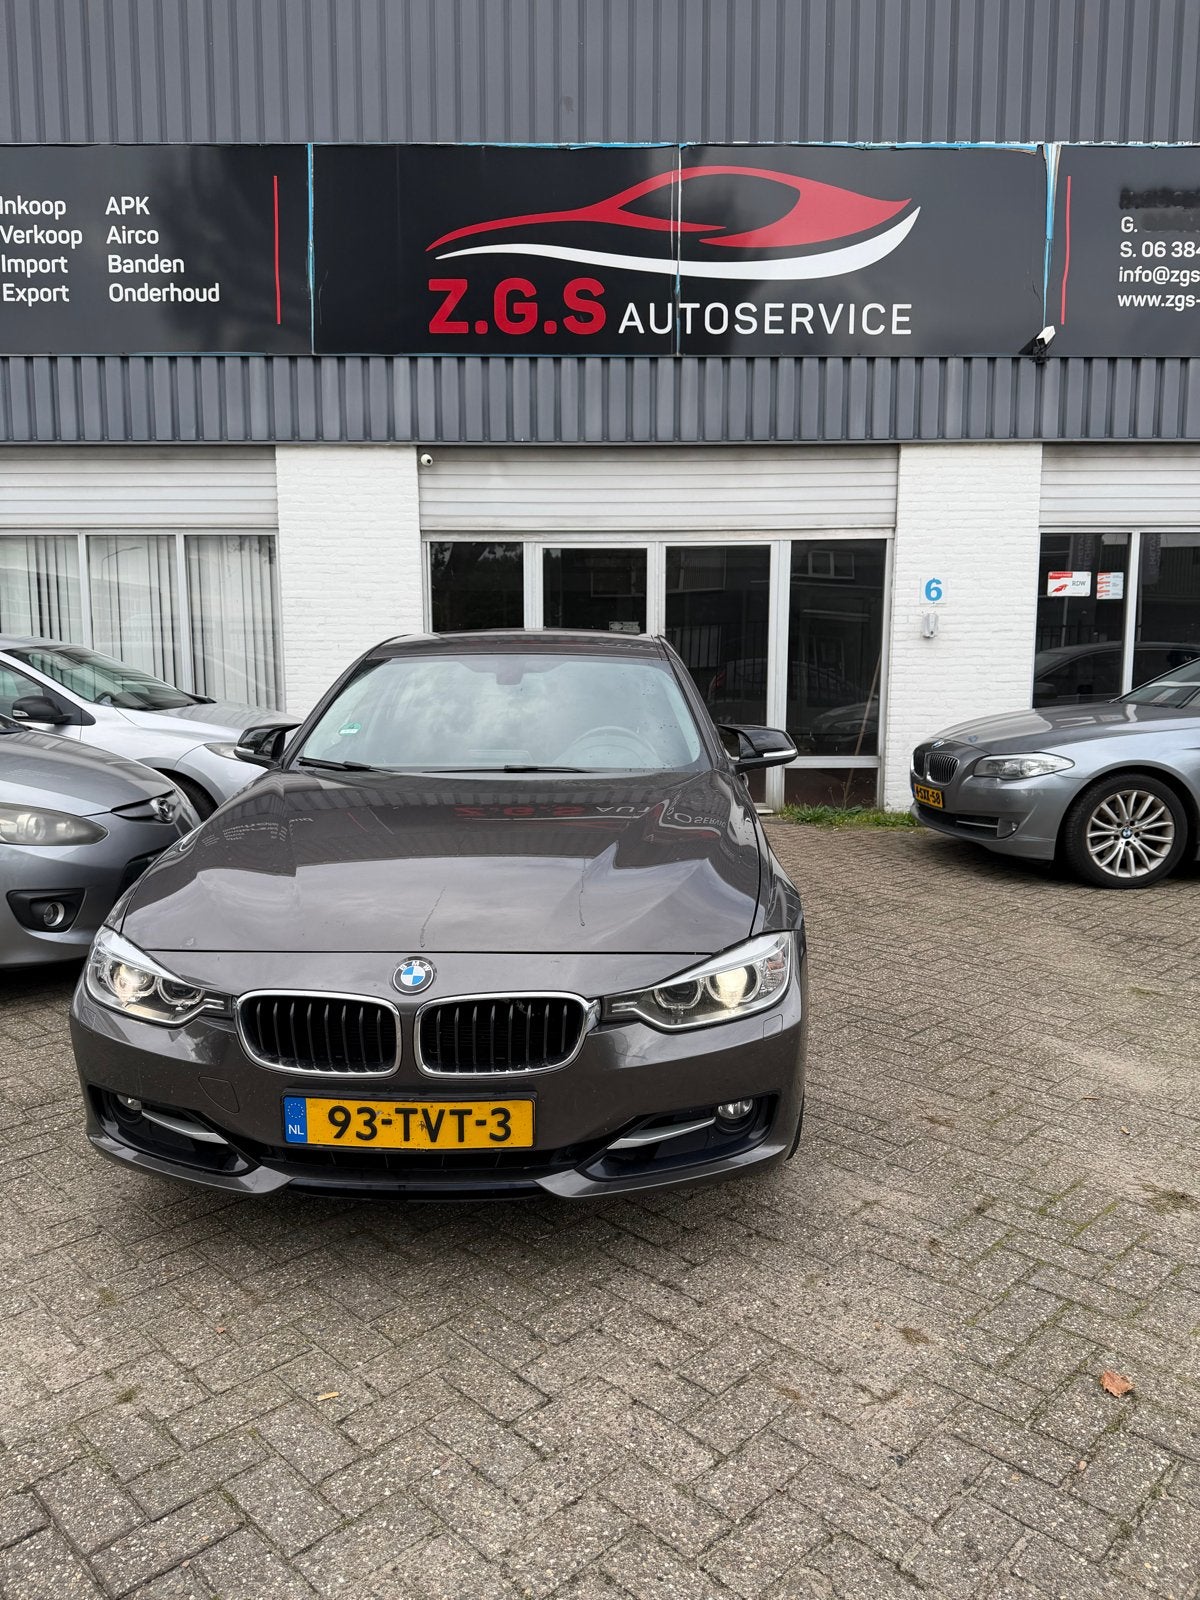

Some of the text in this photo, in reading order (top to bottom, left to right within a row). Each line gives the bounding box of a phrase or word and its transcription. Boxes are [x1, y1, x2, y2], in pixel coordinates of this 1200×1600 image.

[0, 195, 67, 220] Inkoop
[105, 196, 151, 215] APK
[106, 225, 160, 245] Airco
[1121, 216, 1138, 233] G.
[0, 224, 83, 249] Verkoop
[1120, 241, 1137, 258] S.
[1141, 241, 1167, 258] 06
[1, 254, 69, 278] Import
[107, 253, 185, 274] Banden
[2, 283, 70, 307] Export
[108, 283, 220, 303] Onderhoud
[428, 277, 913, 336] Z.G.S AUTOSERVICE
[924, 578, 943, 602] 6
[288, 1124, 304, 1136] NL
[327, 1105, 512, 1143] 93-TVT-3
